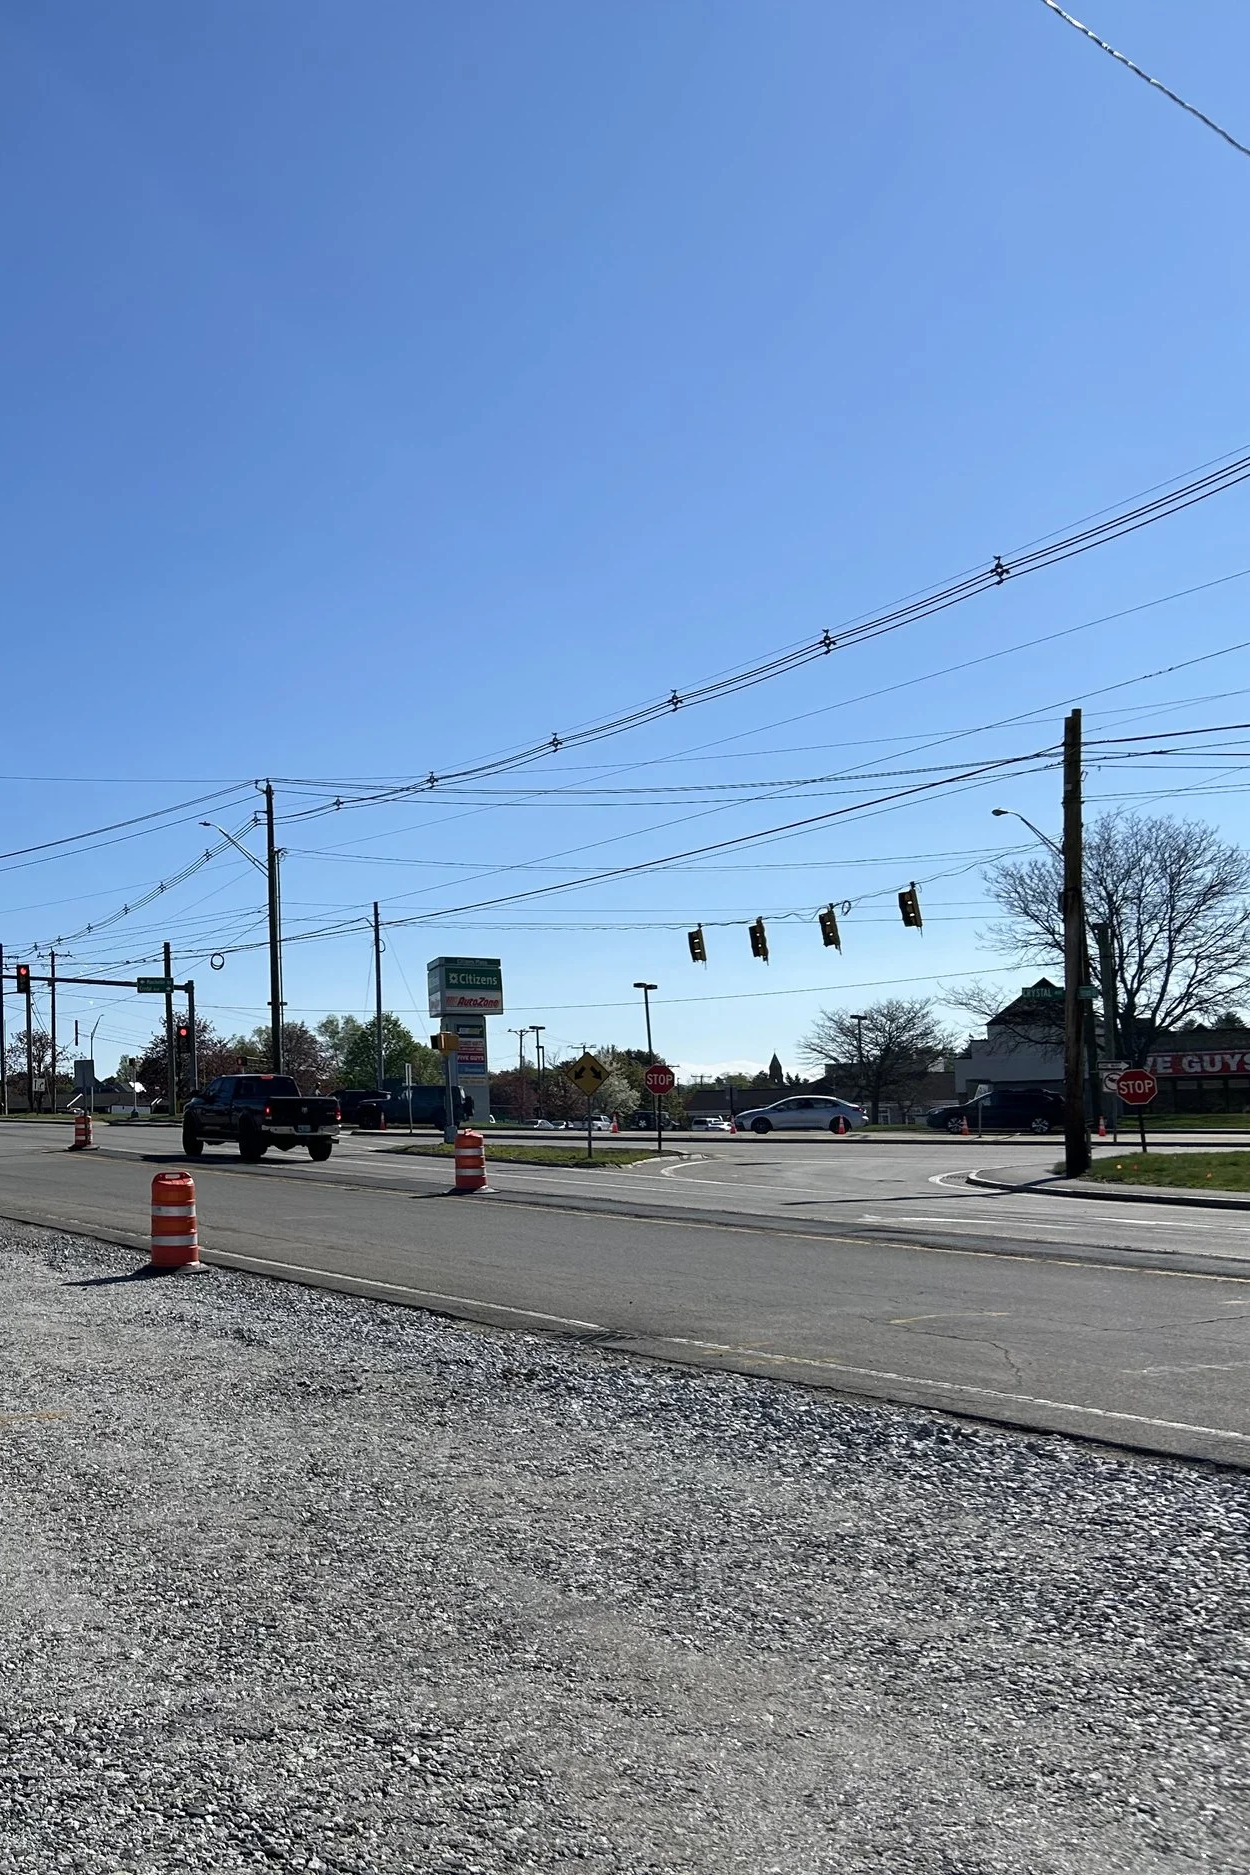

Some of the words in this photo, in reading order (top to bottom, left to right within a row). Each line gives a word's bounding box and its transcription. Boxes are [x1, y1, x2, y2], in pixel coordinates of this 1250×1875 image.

[459, 973, 498, 985] Citizens
[457, 996, 500, 1008] AutoZone
[646, 1073, 673, 1085] STOP
[1119, 1080, 1154, 1094] STOP
